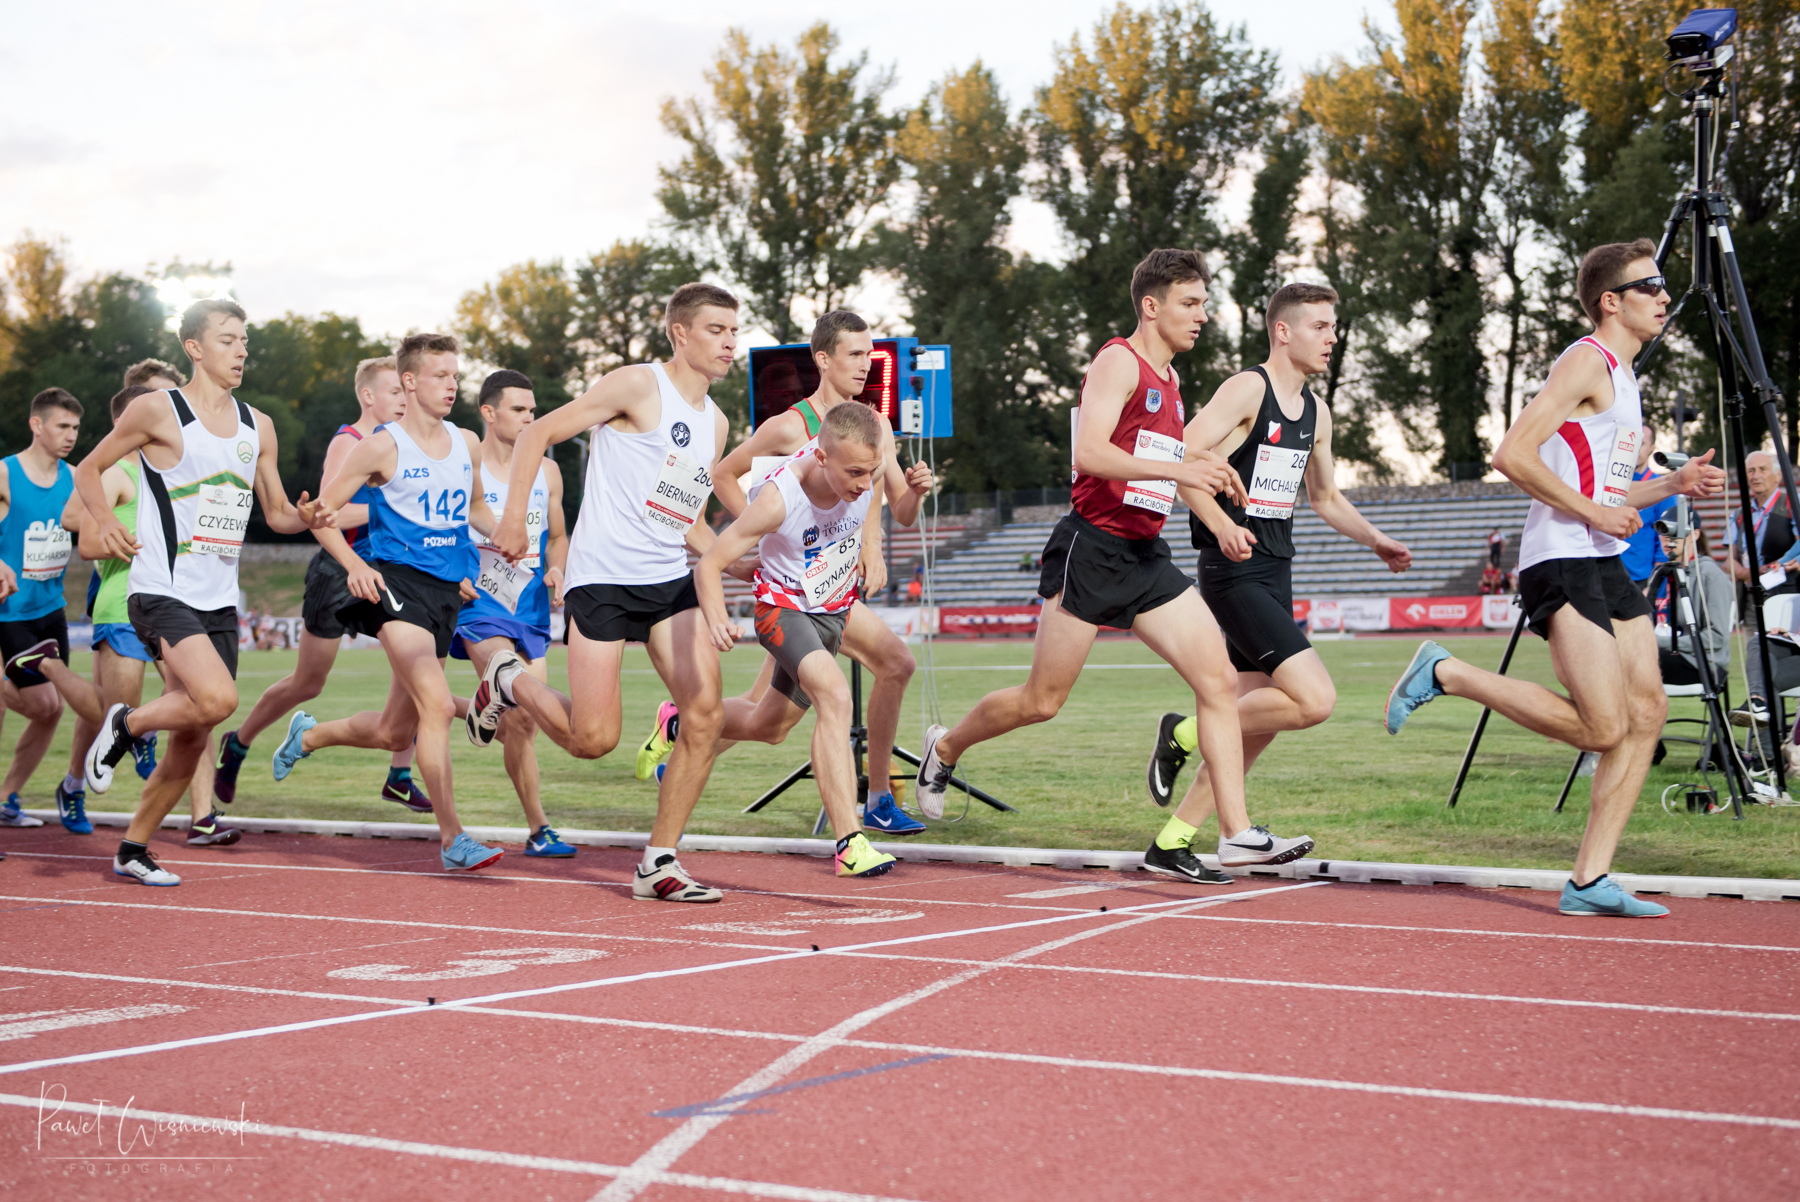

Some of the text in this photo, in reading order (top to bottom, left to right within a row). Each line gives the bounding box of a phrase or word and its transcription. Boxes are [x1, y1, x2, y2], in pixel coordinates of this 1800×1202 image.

[1291, 453, 1306, 469] 26
[403, 467, 430, 479] AZS
[656, 481, 703, 510] BIERNACKI
[418, 489, 467, 522] 142
[1134, 496, 1166, 512] RACIBÓRZ
[648, 509, 676, 529] RACIBÓRZ
[823, 516, 852, 529] MIASTO
[423, 534, 457, 548] POZNAŃ
[839, 536, 856, 555] 85
[26, 550, 70, 562] KUCHARSKI
[201, 543, 236, 556] RACIBÓRZ
[814, 556, 856, 599] SZYNAKA
